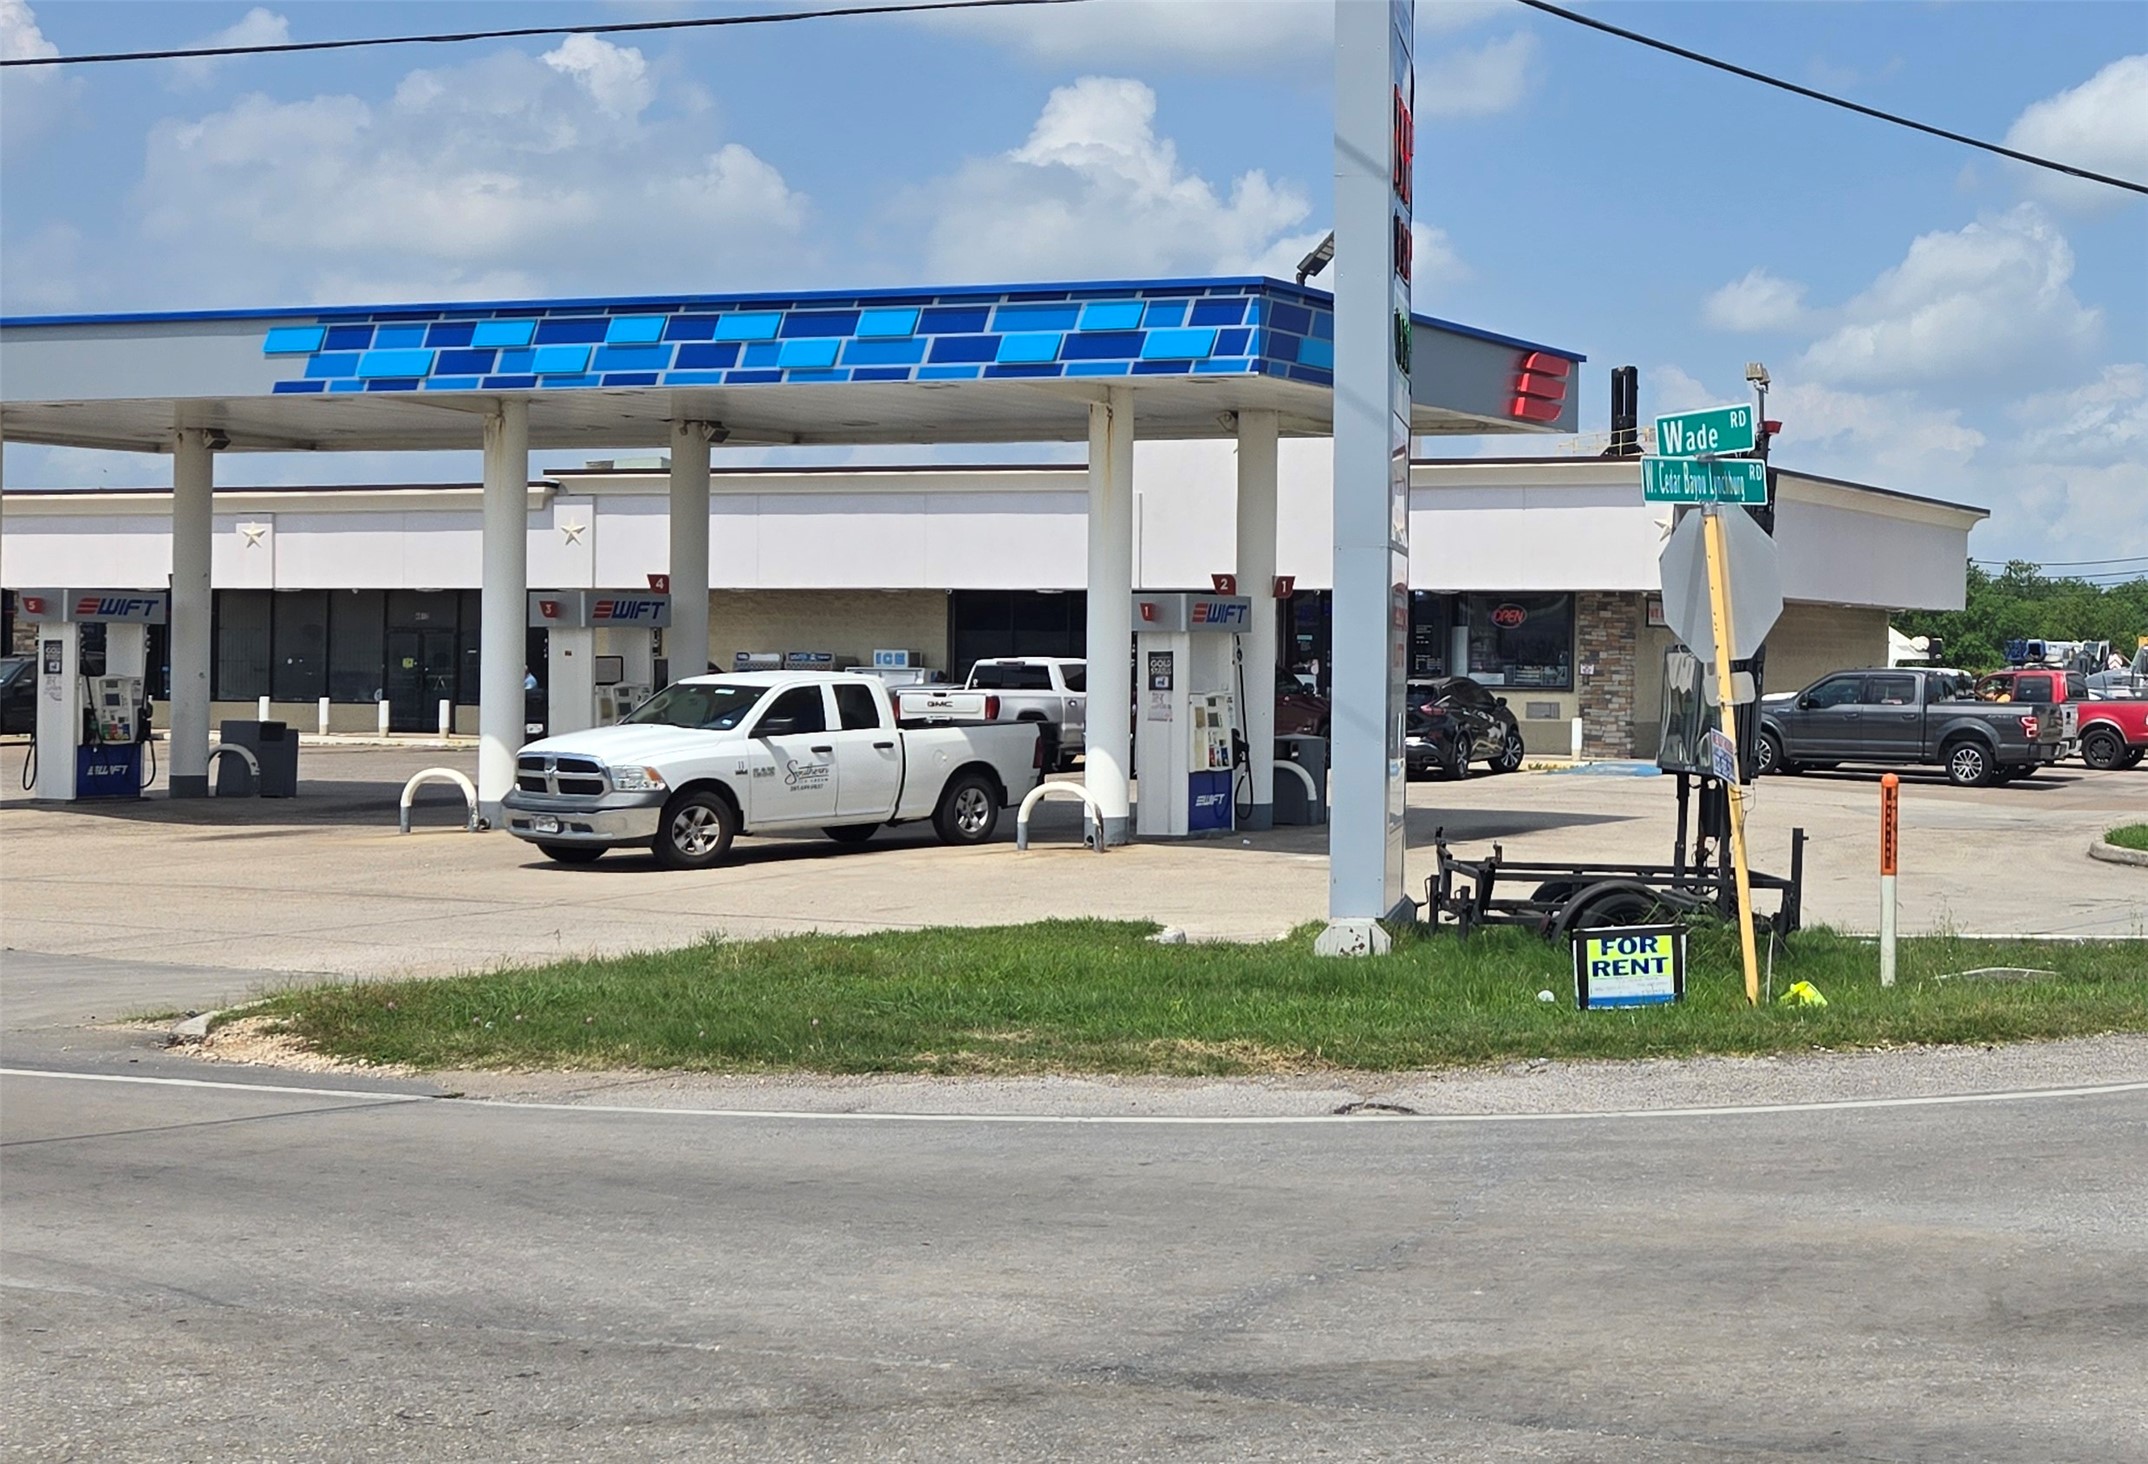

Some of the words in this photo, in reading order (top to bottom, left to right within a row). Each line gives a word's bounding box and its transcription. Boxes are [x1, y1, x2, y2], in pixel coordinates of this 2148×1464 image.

[1662, 419, 1718, 454] Wade
[1730, 410, 1746, 428] RD
[1644, 461, 1657, 493] W.
[1659, 461, 1681, 495] Cedar
[1683, 461, 1706, 500] Bayou
[1709, 462, 1745, 502] Lynchburg
[1749, 464, 1762, 481] RD
[655, 577, 664, 589] 4
[1220, 578, 1228, 590] 2
[1282, 580, 1287, 593] 1
[545, 604, 552, 613] 3
[1493, 609, 1524, 623] OPEN
[875, 652, 906, 665] ICE
[927, 700, 953, 708] GMC
[1601, 935, 1658, 956] FOR
[1592, 957, 1669, 977] RENT
